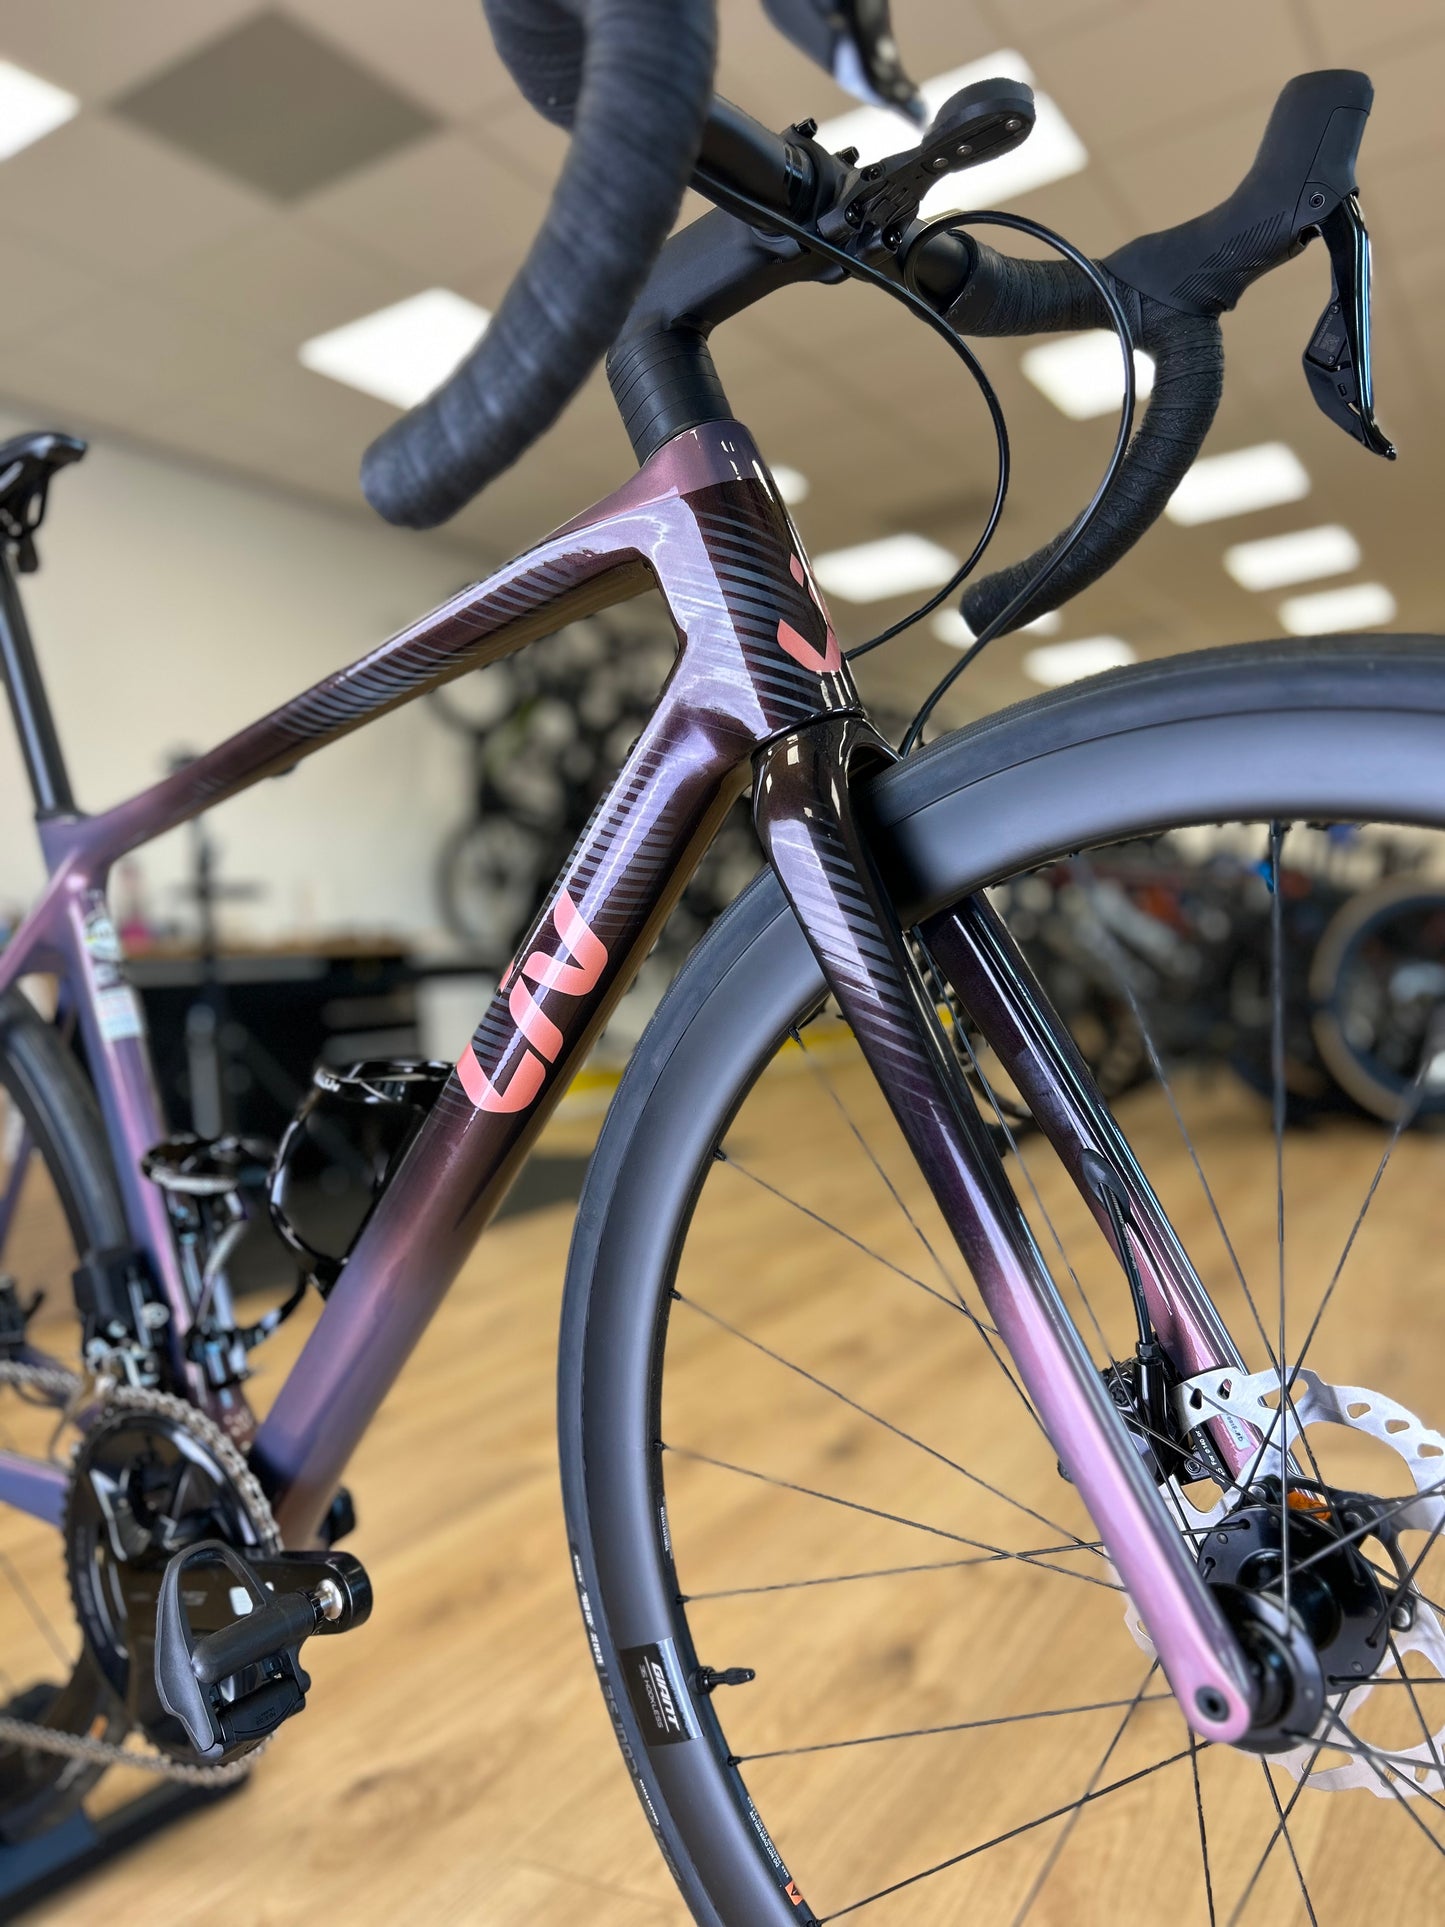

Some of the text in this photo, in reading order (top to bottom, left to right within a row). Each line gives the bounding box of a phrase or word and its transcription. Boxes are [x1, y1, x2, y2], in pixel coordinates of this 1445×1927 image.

[643, 1680, 663, 1728] HOOKLESS
[651, 1662, 680, 1731] GIANT
[759, 1832, 769, 1847] OVER
[766, 1846, 774, 1858] NOT
